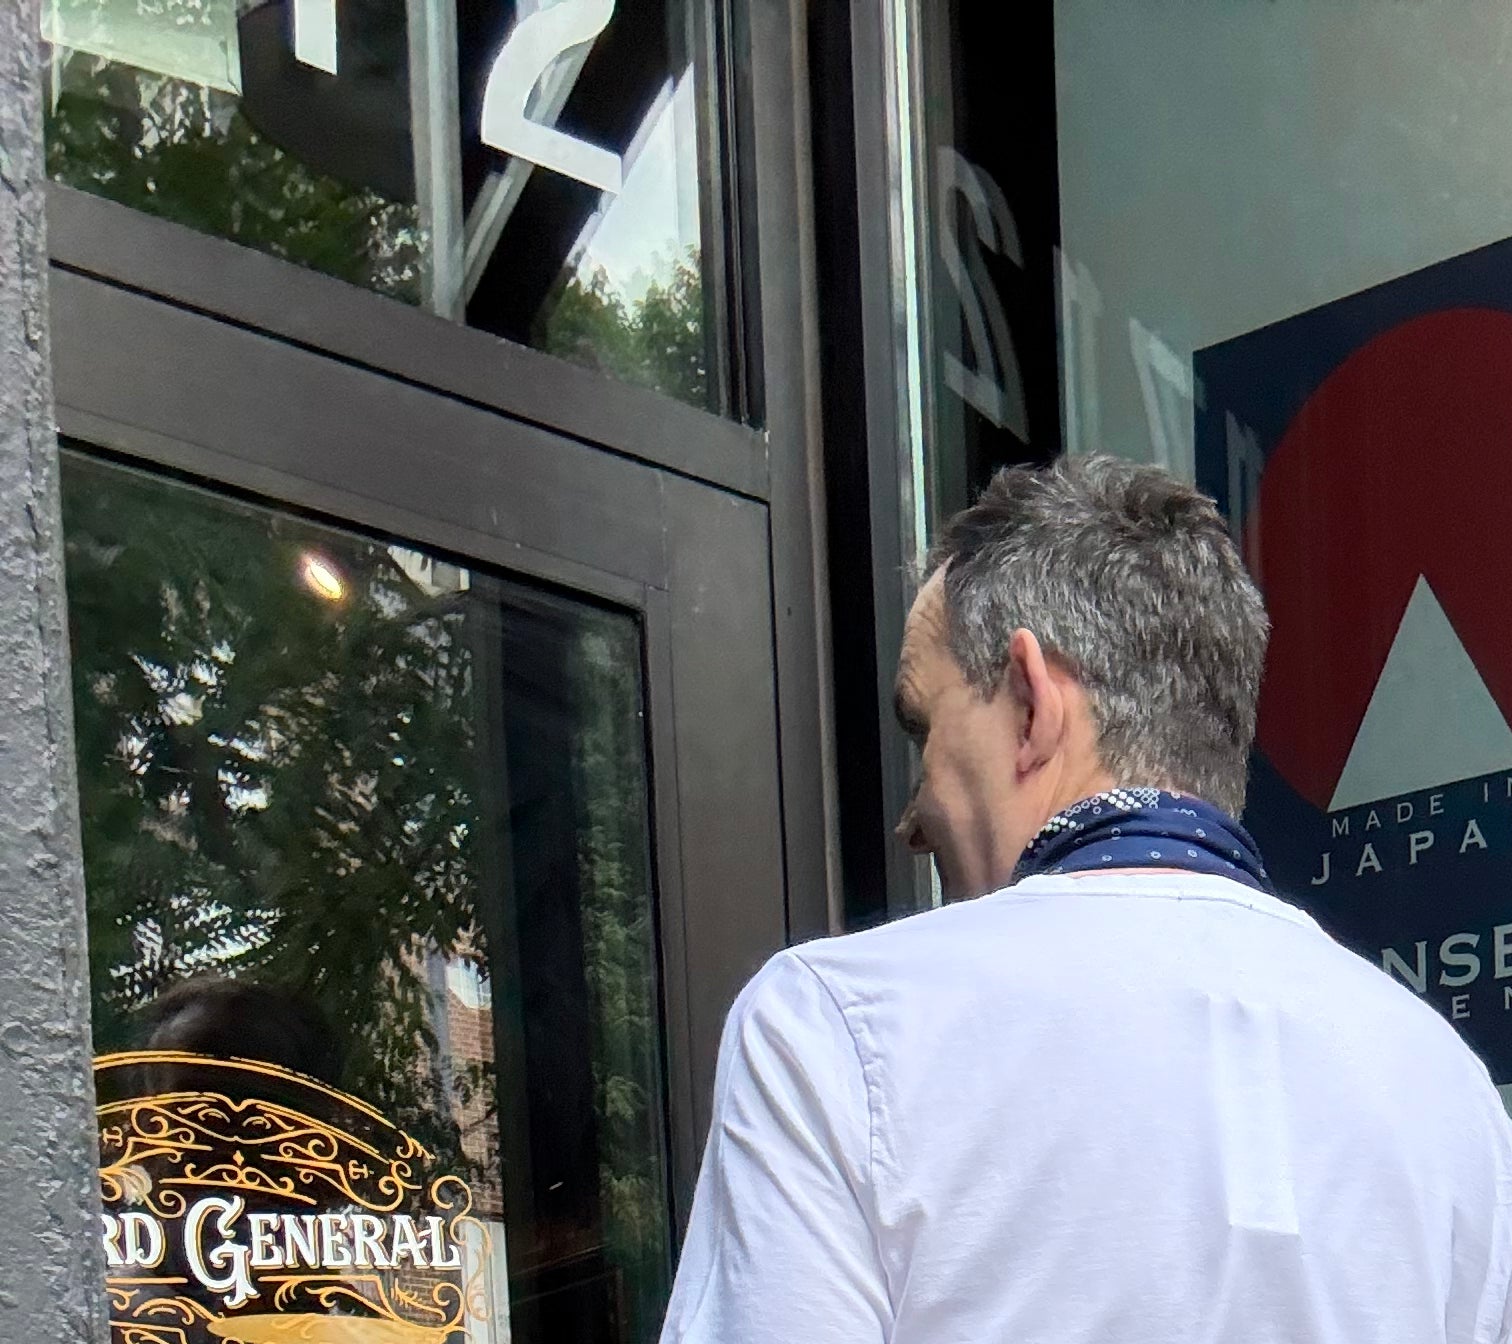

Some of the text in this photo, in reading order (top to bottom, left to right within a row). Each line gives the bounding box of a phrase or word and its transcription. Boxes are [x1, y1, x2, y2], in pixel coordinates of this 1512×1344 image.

[1332, 794, 1444, 838] MADE
[101, 1195, 462, 1309] RD GENERAL
